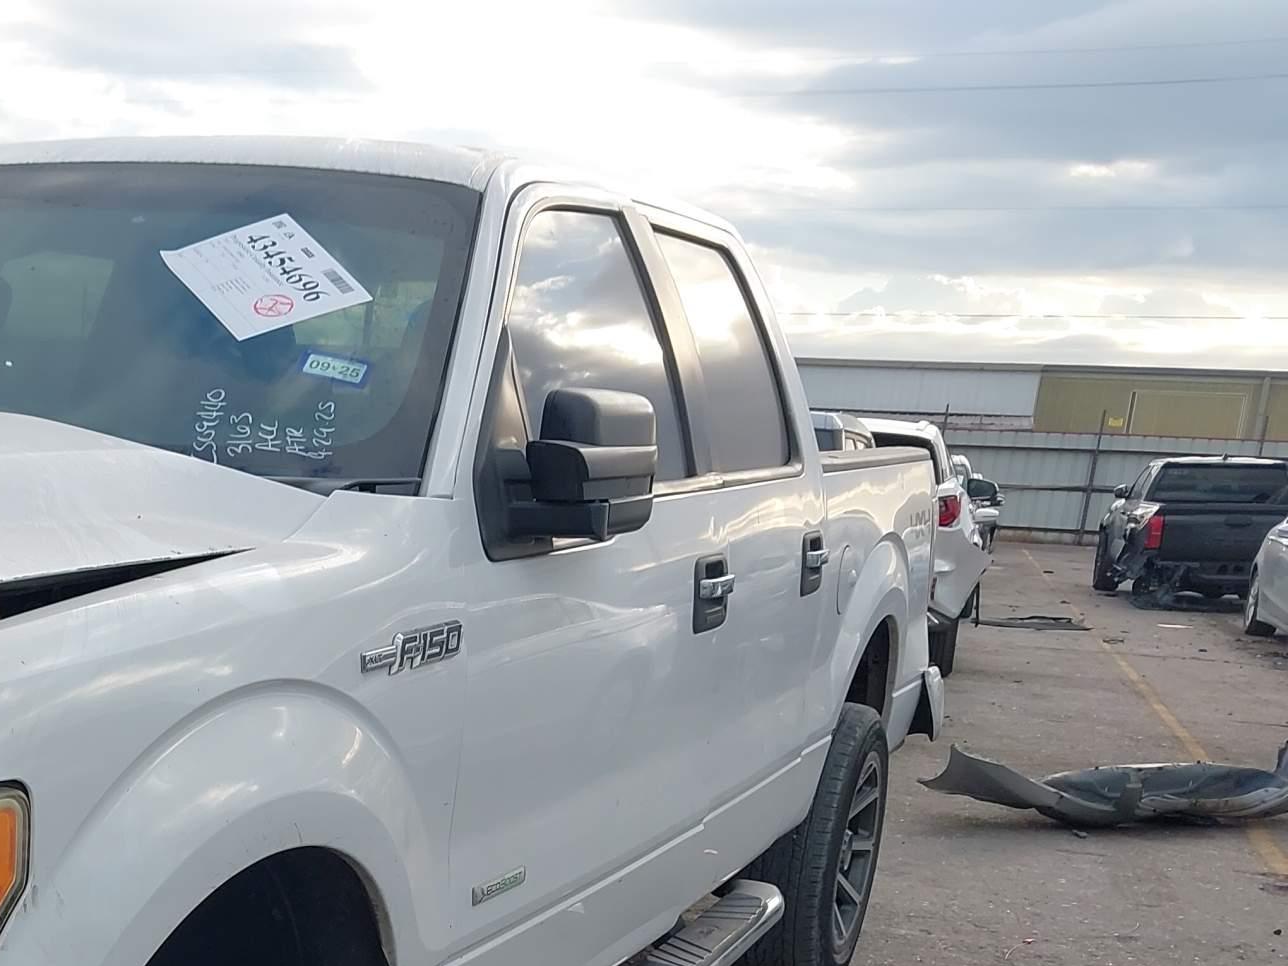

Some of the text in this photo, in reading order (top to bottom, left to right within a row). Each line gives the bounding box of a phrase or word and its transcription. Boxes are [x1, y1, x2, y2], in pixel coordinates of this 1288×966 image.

[246, 234, 331, 303] 43454696
[309, 360, 361, 378] 09 25
[226, 412, 253, 457] 3163
